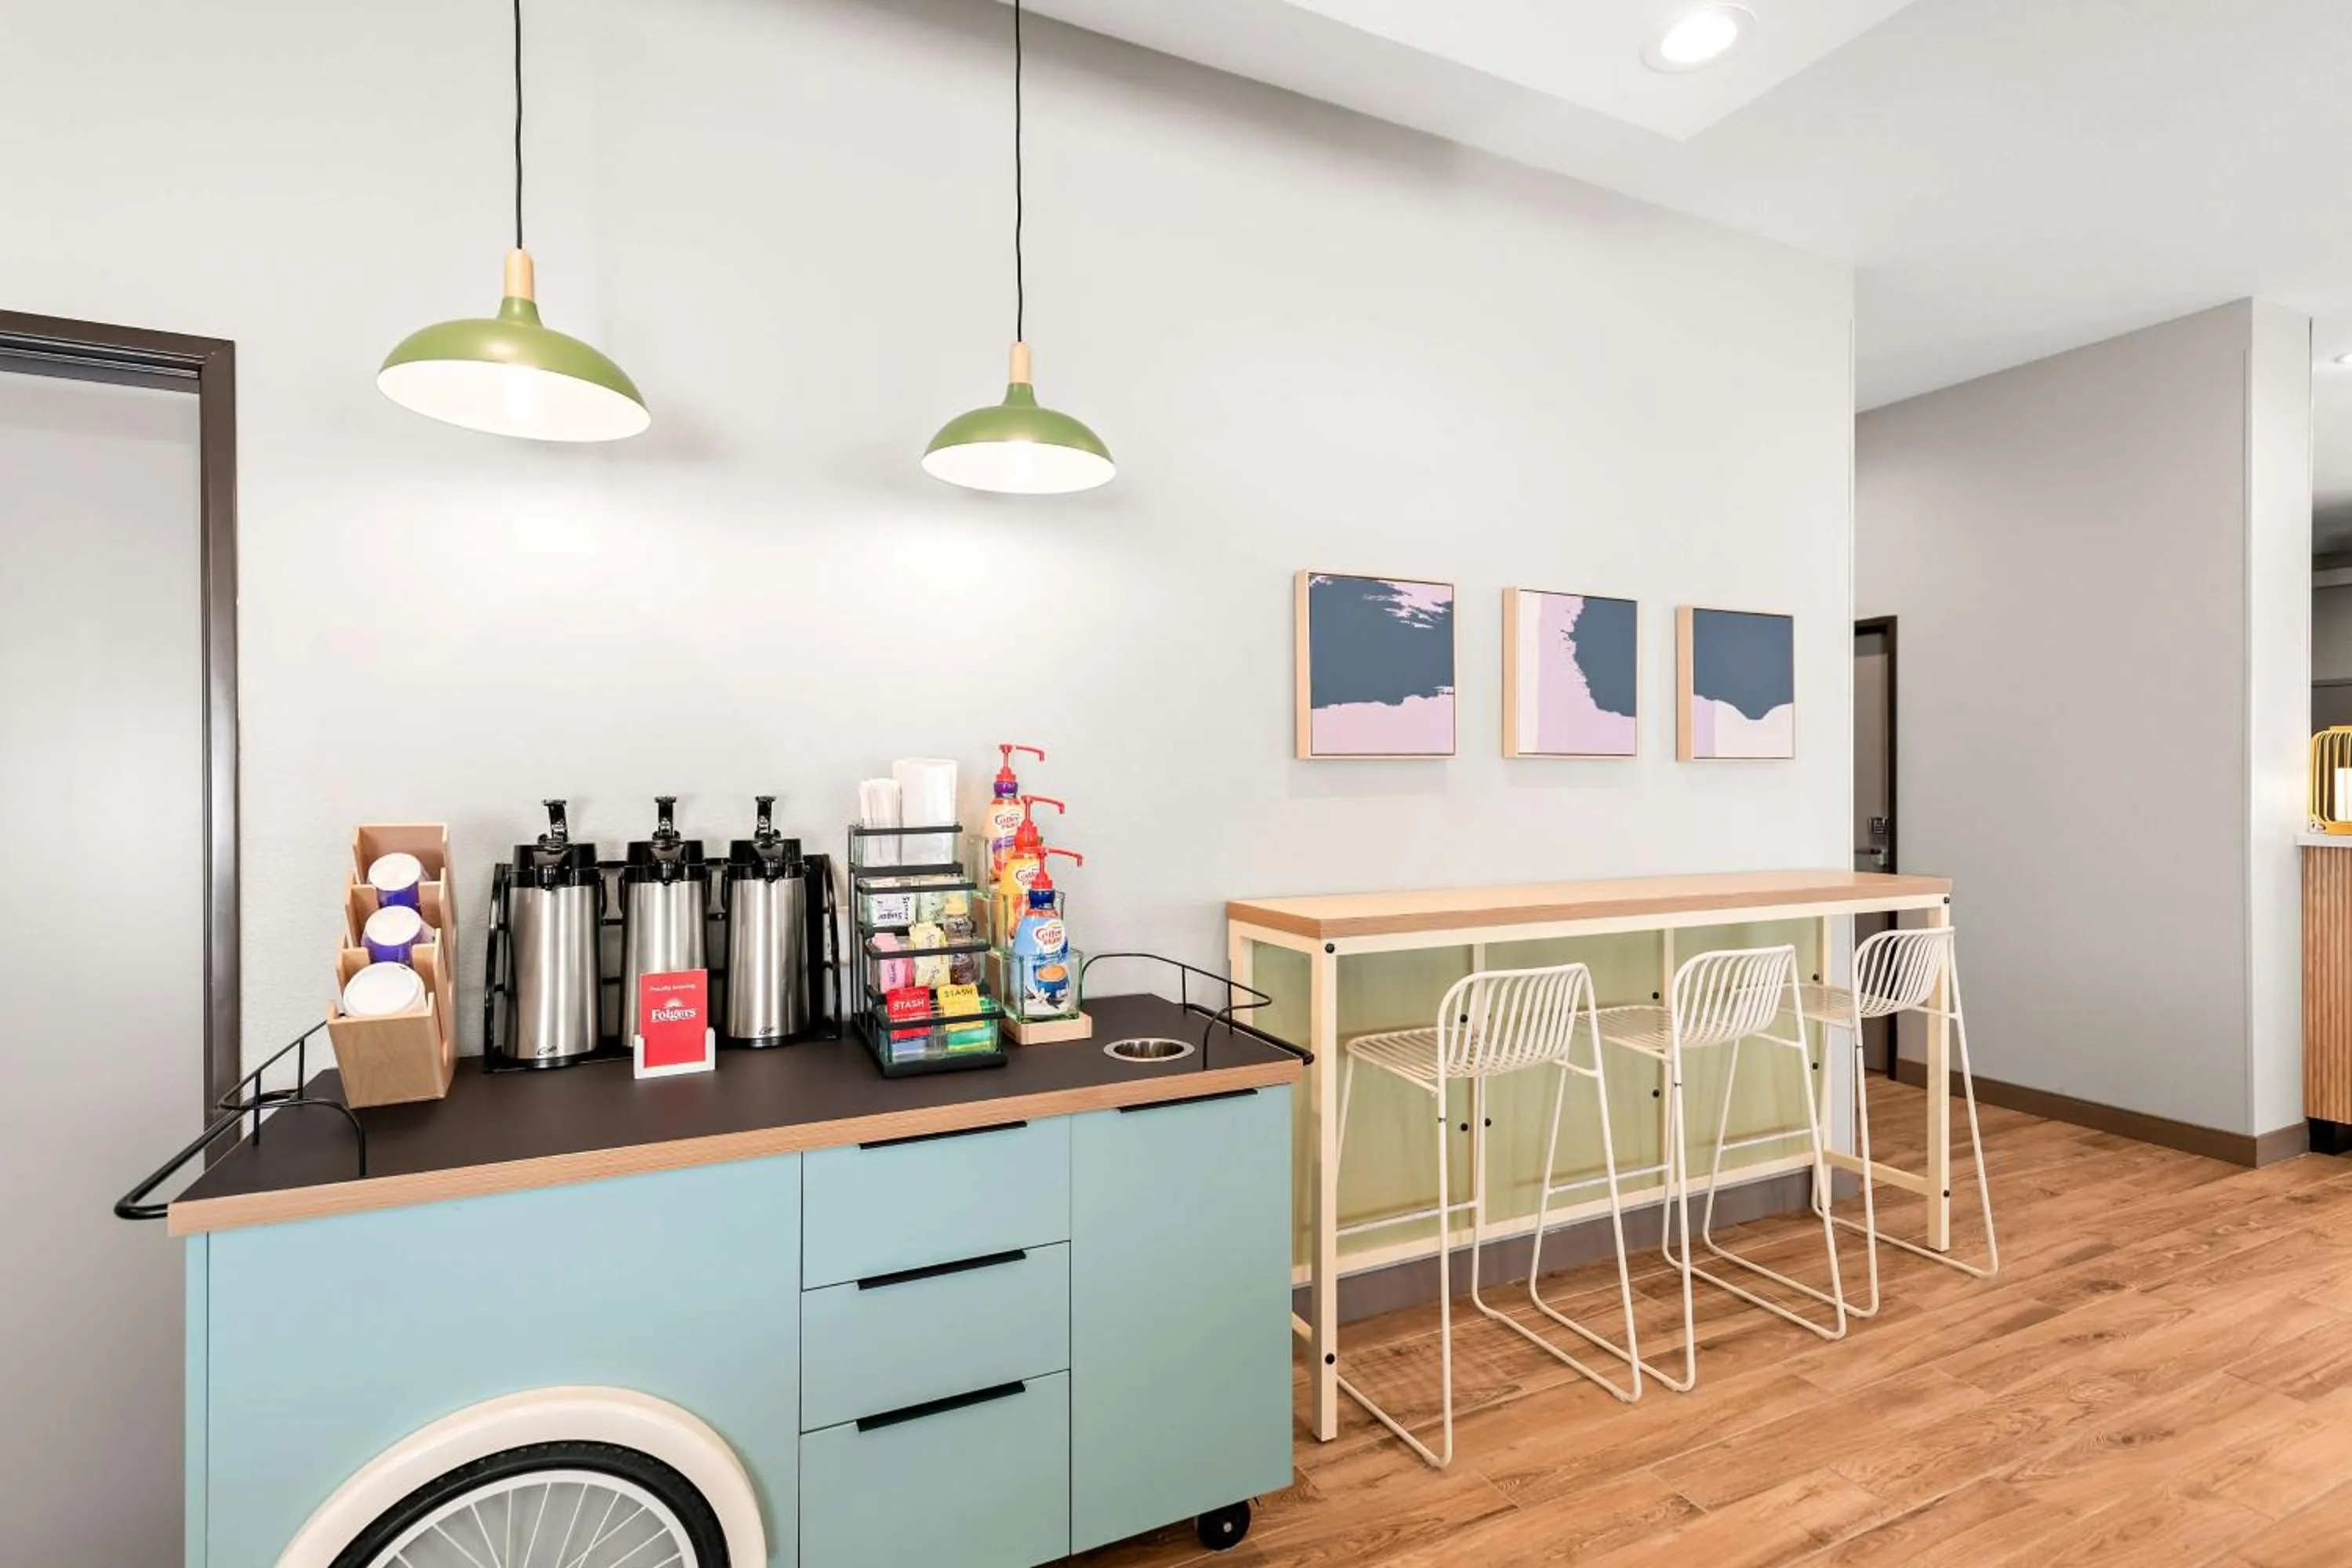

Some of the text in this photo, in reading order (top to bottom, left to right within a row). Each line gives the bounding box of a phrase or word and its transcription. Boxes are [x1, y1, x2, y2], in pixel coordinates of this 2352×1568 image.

[944, 989, 974, 998] STASH
[892, 998, 924, 1011] STASH
[652, 1007, 697, 1022] Folgers
